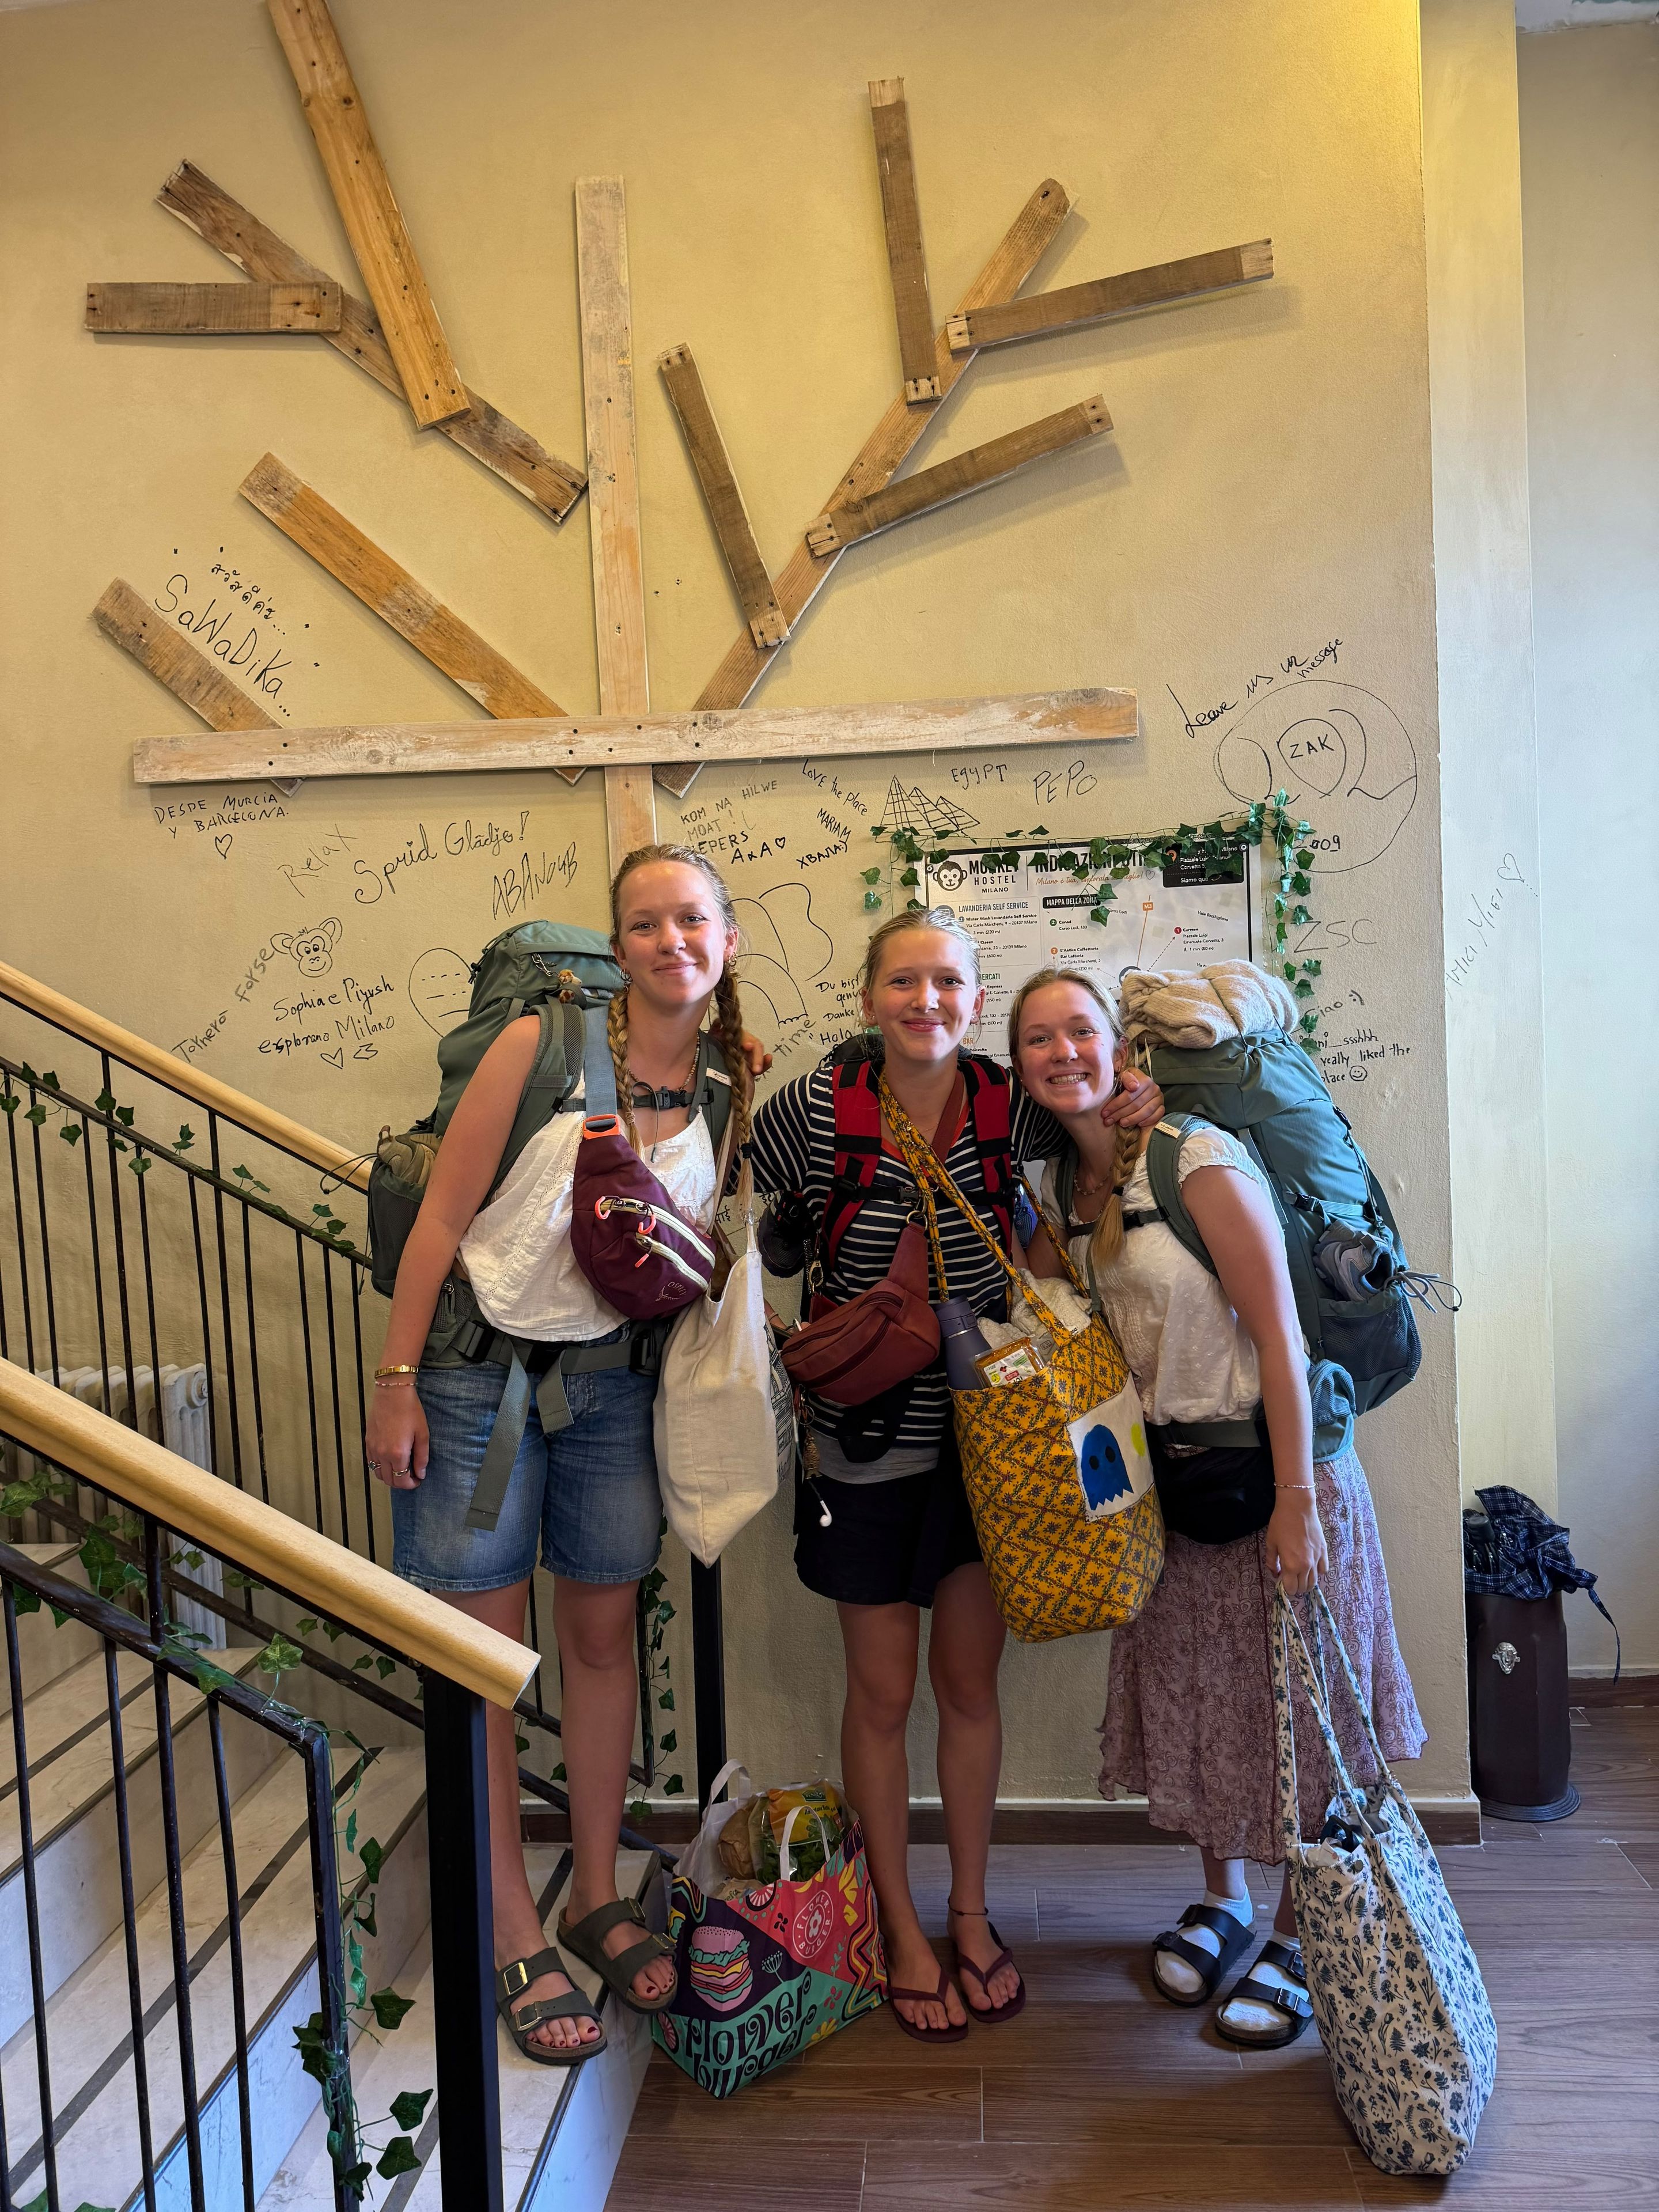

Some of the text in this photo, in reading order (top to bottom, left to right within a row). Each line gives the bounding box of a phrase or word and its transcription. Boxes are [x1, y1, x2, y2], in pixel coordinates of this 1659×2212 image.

[1290, 733, 1335, 759] ZAK
[831, 777, 842, 798] the
[1033, 760, 1097, 805] PEPO
[680, 807, 706, 824] KOM
[716, 798, 732, 812] NA
[168, 827, 177, 839] Y
[687, 819, 721, 841] MOAT
[974, 875, 1016, 885] HOSTEL
[1036, 877, 1059, 885] Milano
[959, 904, 991, 912] LAVANDERIA
[1046, 896, 1097, 906] MAPPA DELLA ZONA
[1290, 919, 1377, 953] ZSC
[815, 982, 835, 993] Du
[274, 990, 325, 1025] Sophia
[335, 1015, 395, 1041] Milano
[1359, 1045, 1385, 1062] liked
[1389, 1043, 1411, 1056] the
